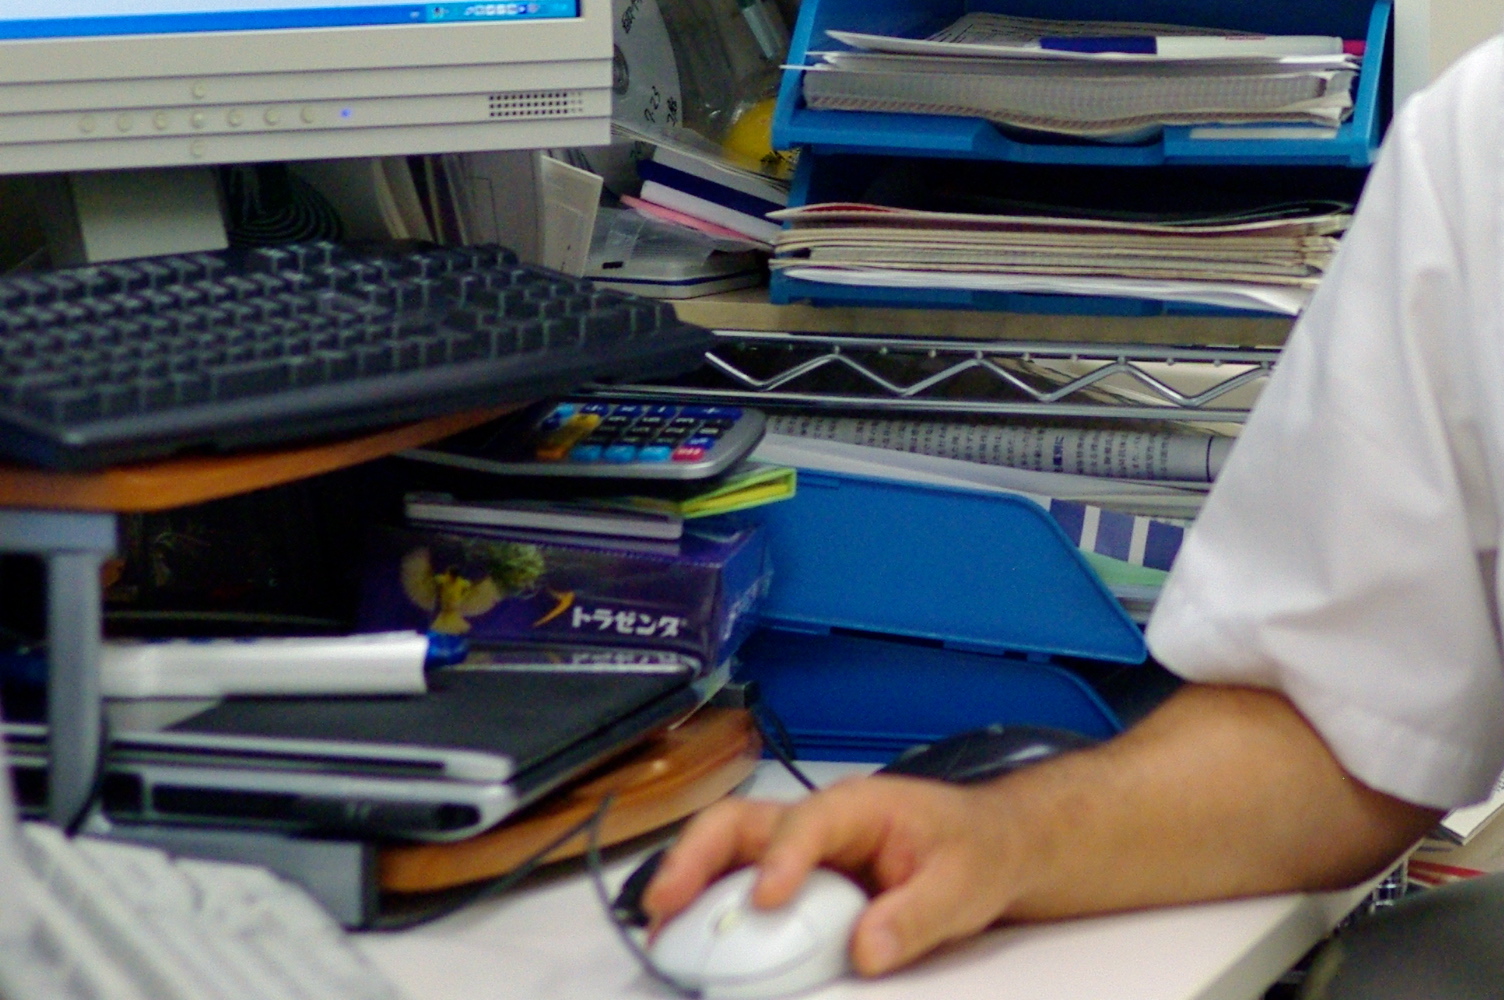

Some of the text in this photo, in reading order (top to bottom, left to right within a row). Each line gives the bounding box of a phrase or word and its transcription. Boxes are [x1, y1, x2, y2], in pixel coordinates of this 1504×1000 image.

[573, 607, 681, 637] トラゼンダ
